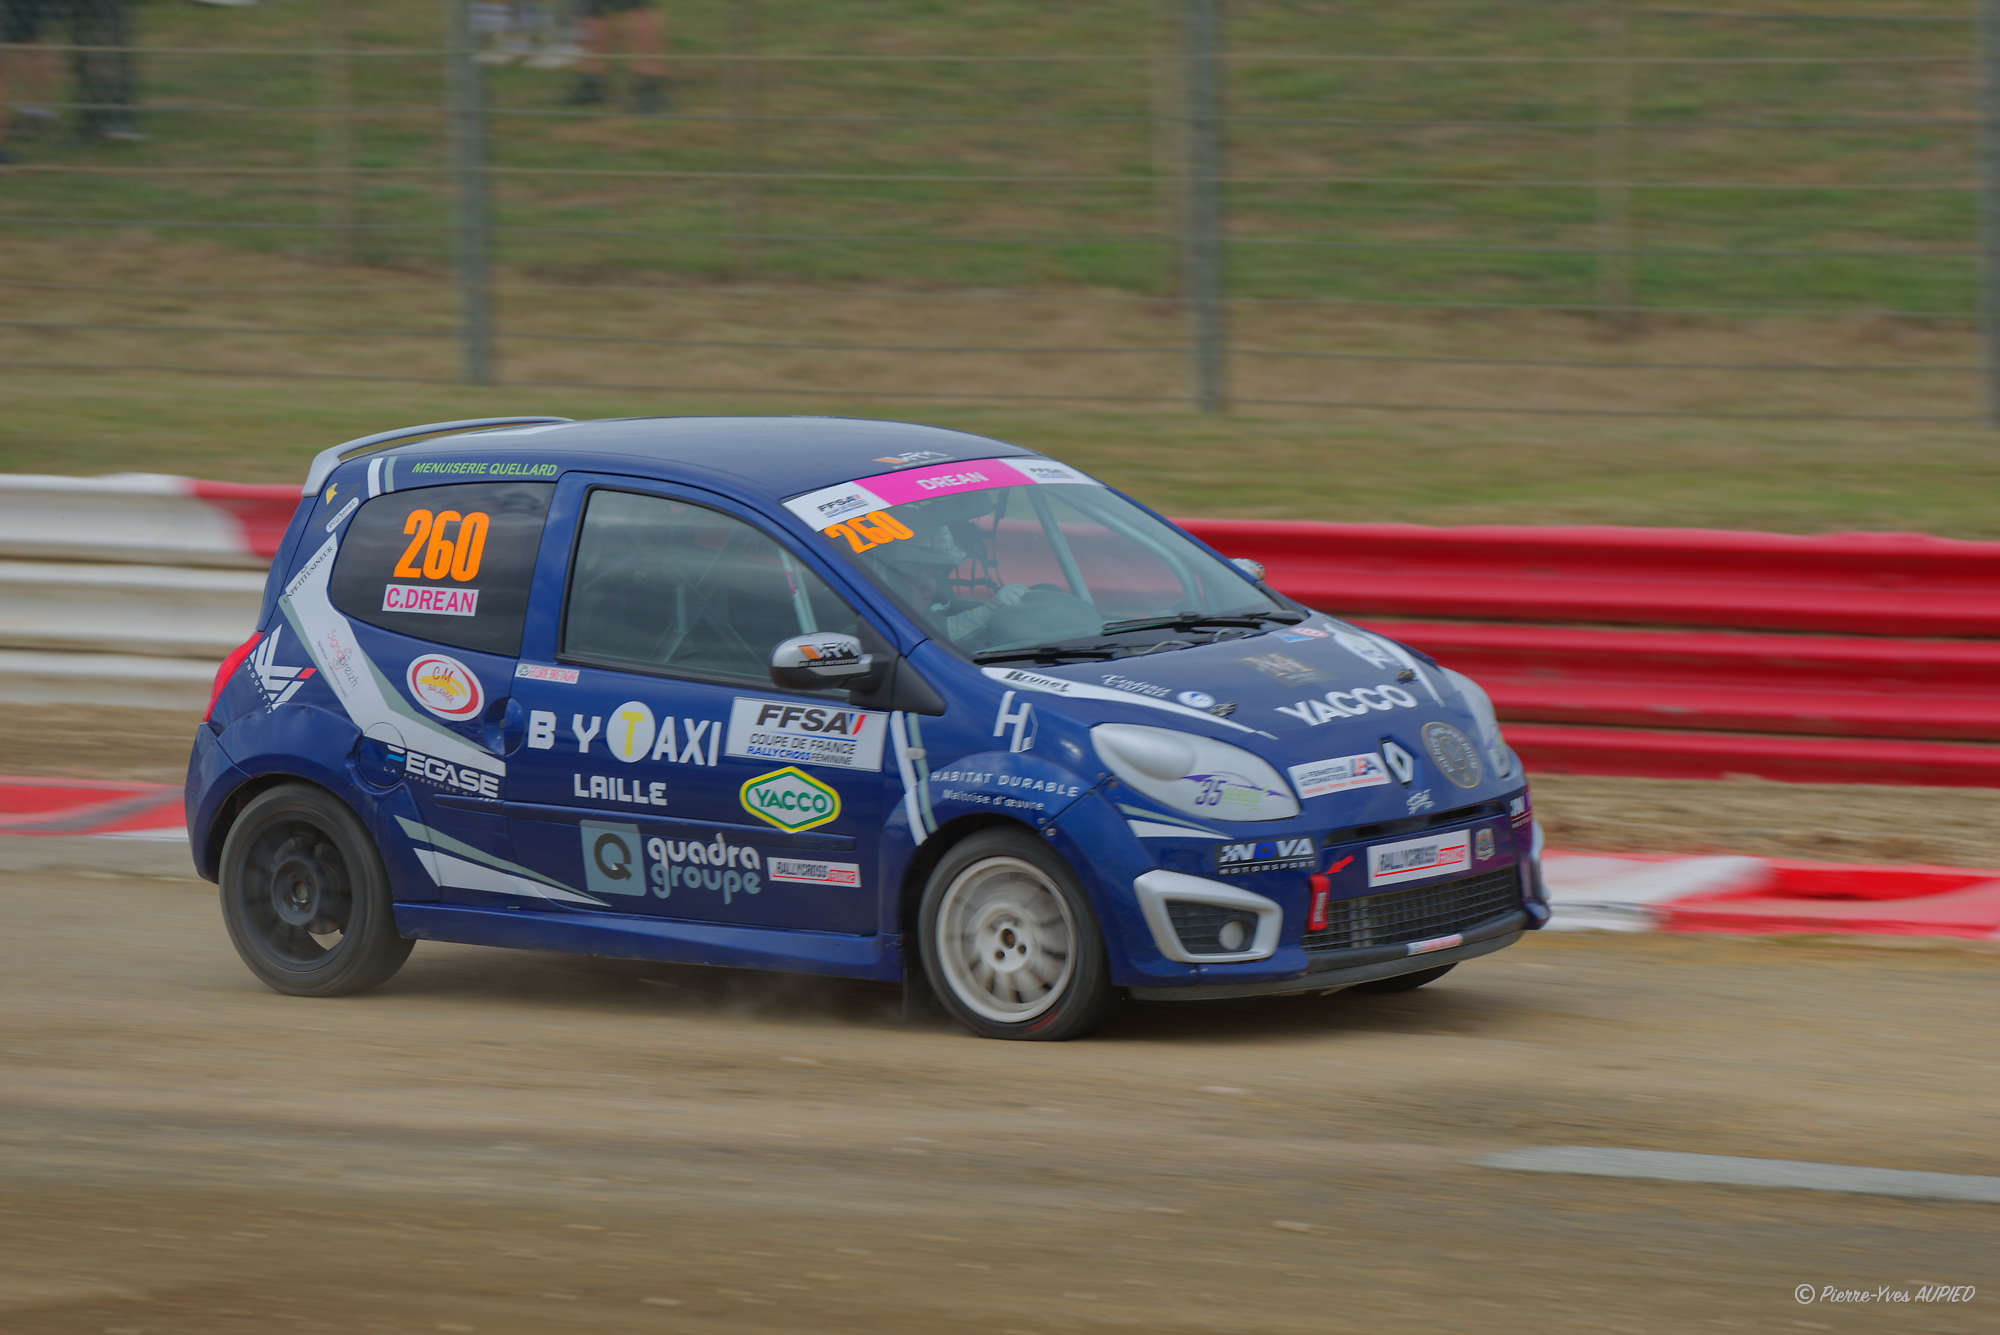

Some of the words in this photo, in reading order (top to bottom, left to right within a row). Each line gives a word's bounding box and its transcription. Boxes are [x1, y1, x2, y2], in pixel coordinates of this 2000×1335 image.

[412, 462, 488, 475] MENUISERIE
[489, 463, 558, 476] QUELLARD
[916, 471, 990, 490] DREAN
[393, 509, 490, 582] 260
[824, 510, 914, 553] 260
[387, 587, 475, 613] C.DREAN
[756, 704, 848, 735] FFSA
[1273, 684, 1418, 727] YACCO
[750, 733, 788, 747] COUPE
[792, 738, 807, 749] DE
[809, 740, 855, 754] FRANCE
[574, 773, 668, 806] LAILLE
[930, 771, 993, 784] HABITAT
[997, 774, 1081, 798] DURABLE
[1194, 779, 1228, 806] 35
[755, 788, 827, 814] YACCO
[594, 833, 632, 880] Q
[647, 832, 761, 871] quadra
[651, 862, 761, 905] groupe
